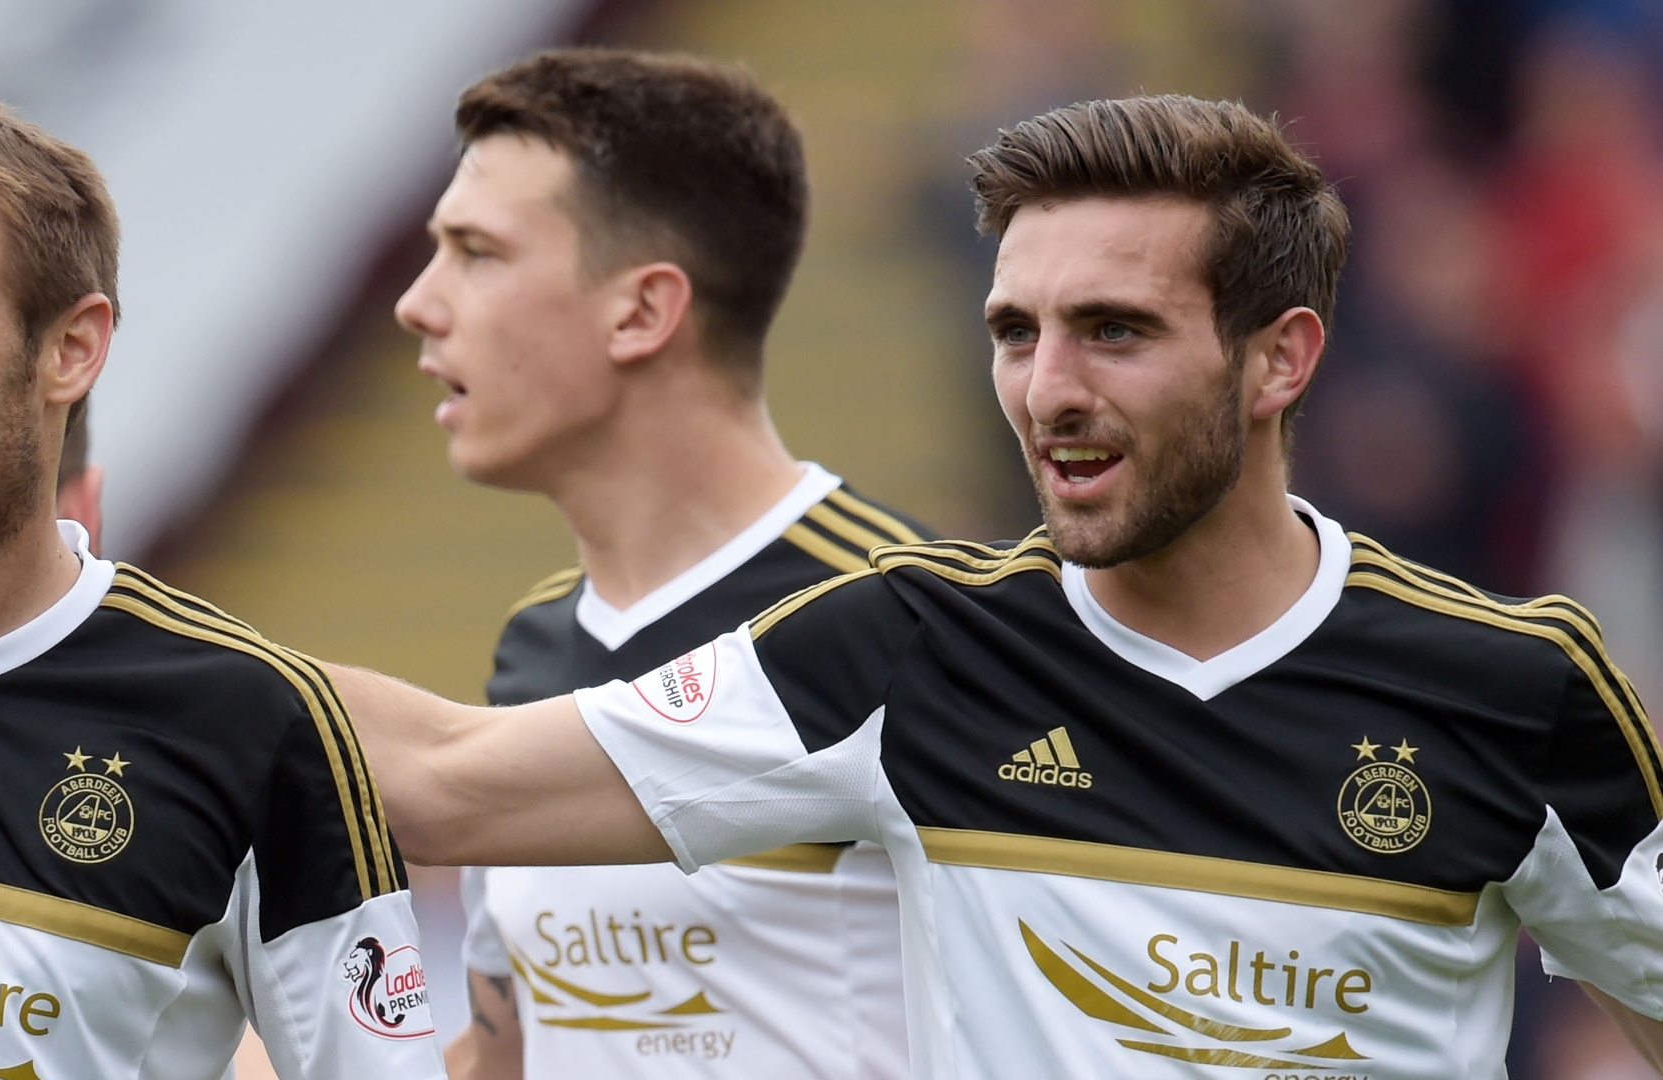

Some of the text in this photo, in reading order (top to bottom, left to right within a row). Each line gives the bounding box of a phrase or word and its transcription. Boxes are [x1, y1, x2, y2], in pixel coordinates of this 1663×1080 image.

[60, 778, 124, 806] ABERDEEN
[998, 762, 1093, 789] adidas
[1354, 766, 1418, 792] ABERDEEN
[43, 817, 128, 859] FOOTBALL CLUB
[1342, 810, 1426, 849] FOOTBALL CLUB
[535, 909, 717, 968] Saltire
[1147, 933, 1372, 1014] Saltire
[637, 1030, 736, 1059] energy
